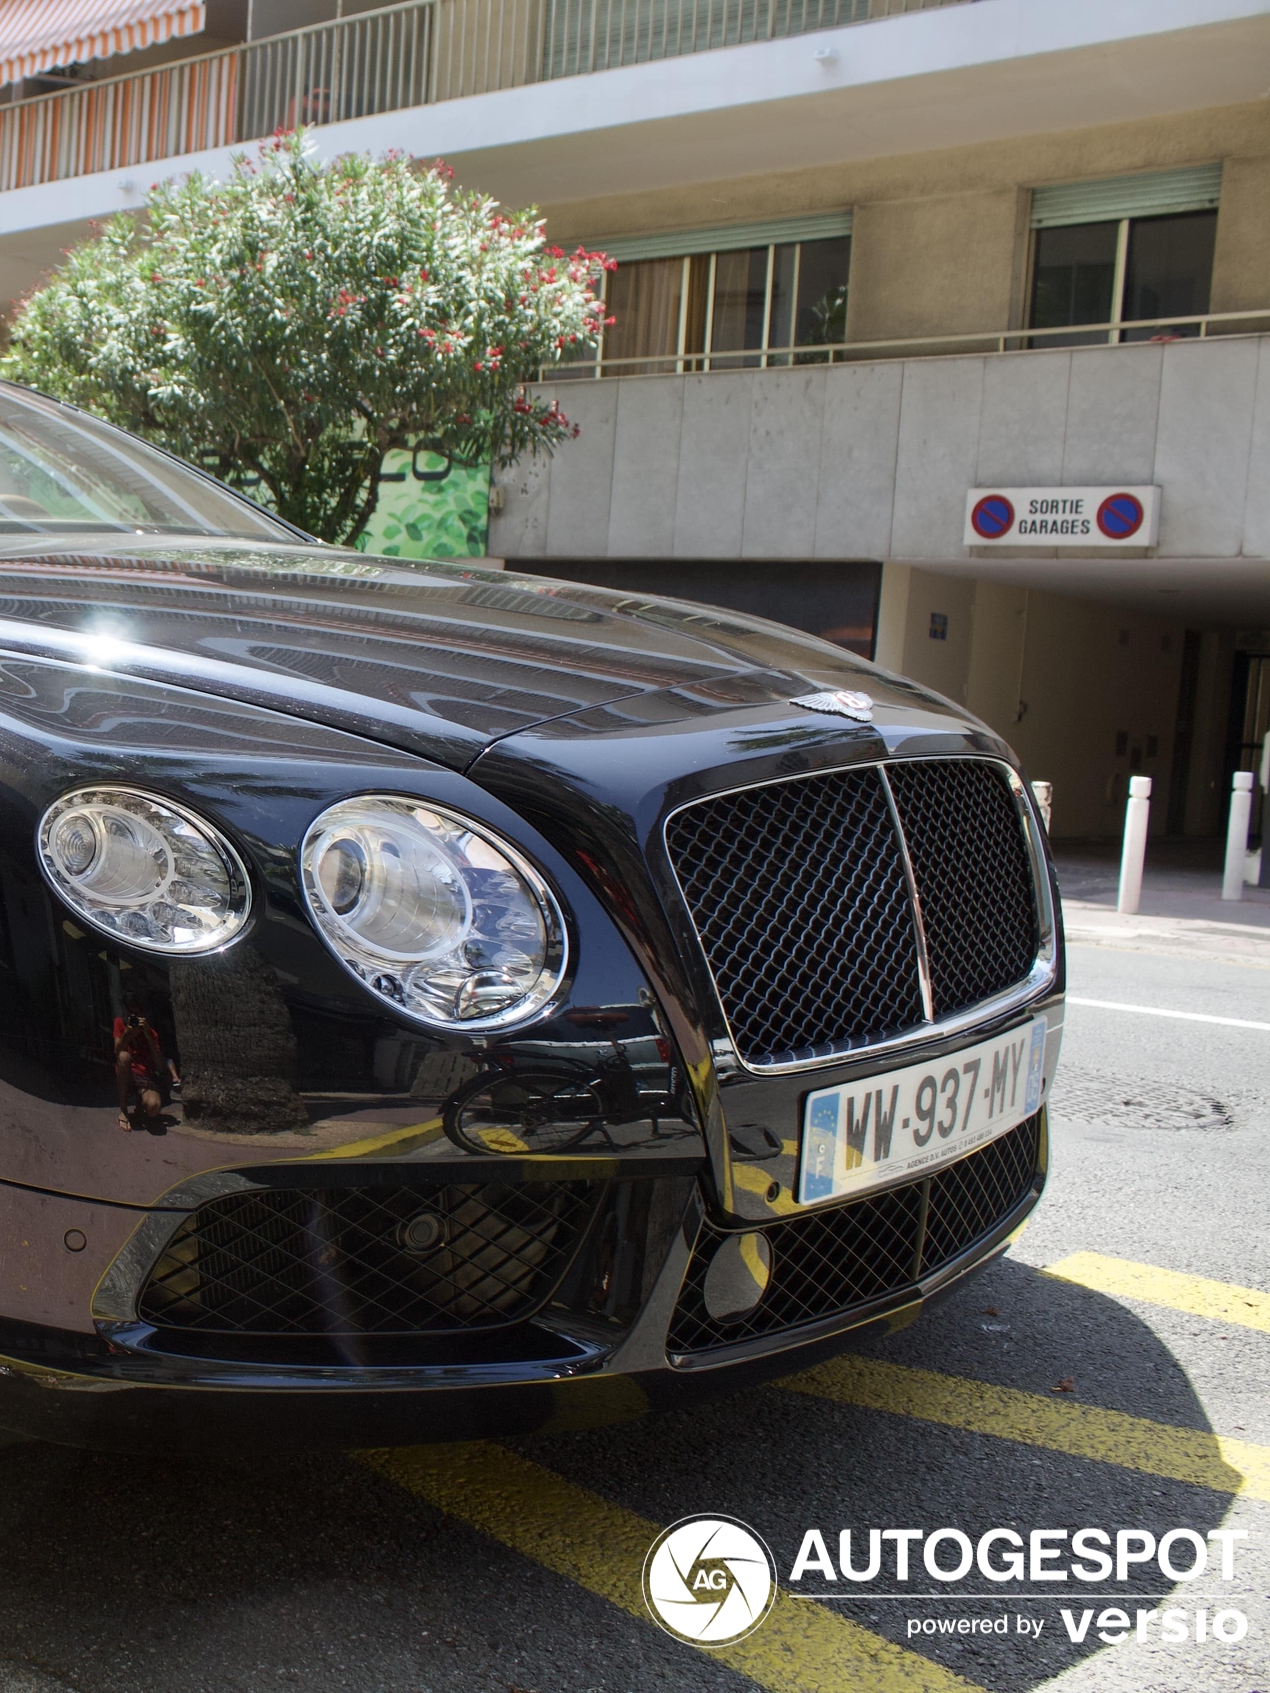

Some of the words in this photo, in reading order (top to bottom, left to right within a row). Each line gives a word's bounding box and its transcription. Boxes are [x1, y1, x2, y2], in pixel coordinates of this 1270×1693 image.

[1028, 499, 1084, 515] SORTIE
[1018, 519, 1091, 535] GARAGES
[845, 1038, 1025, 1171] WW-937-MY
[906, 1154, 930, 1170] AGENCE
[940, 1144, 958, 1158] AUTOS
